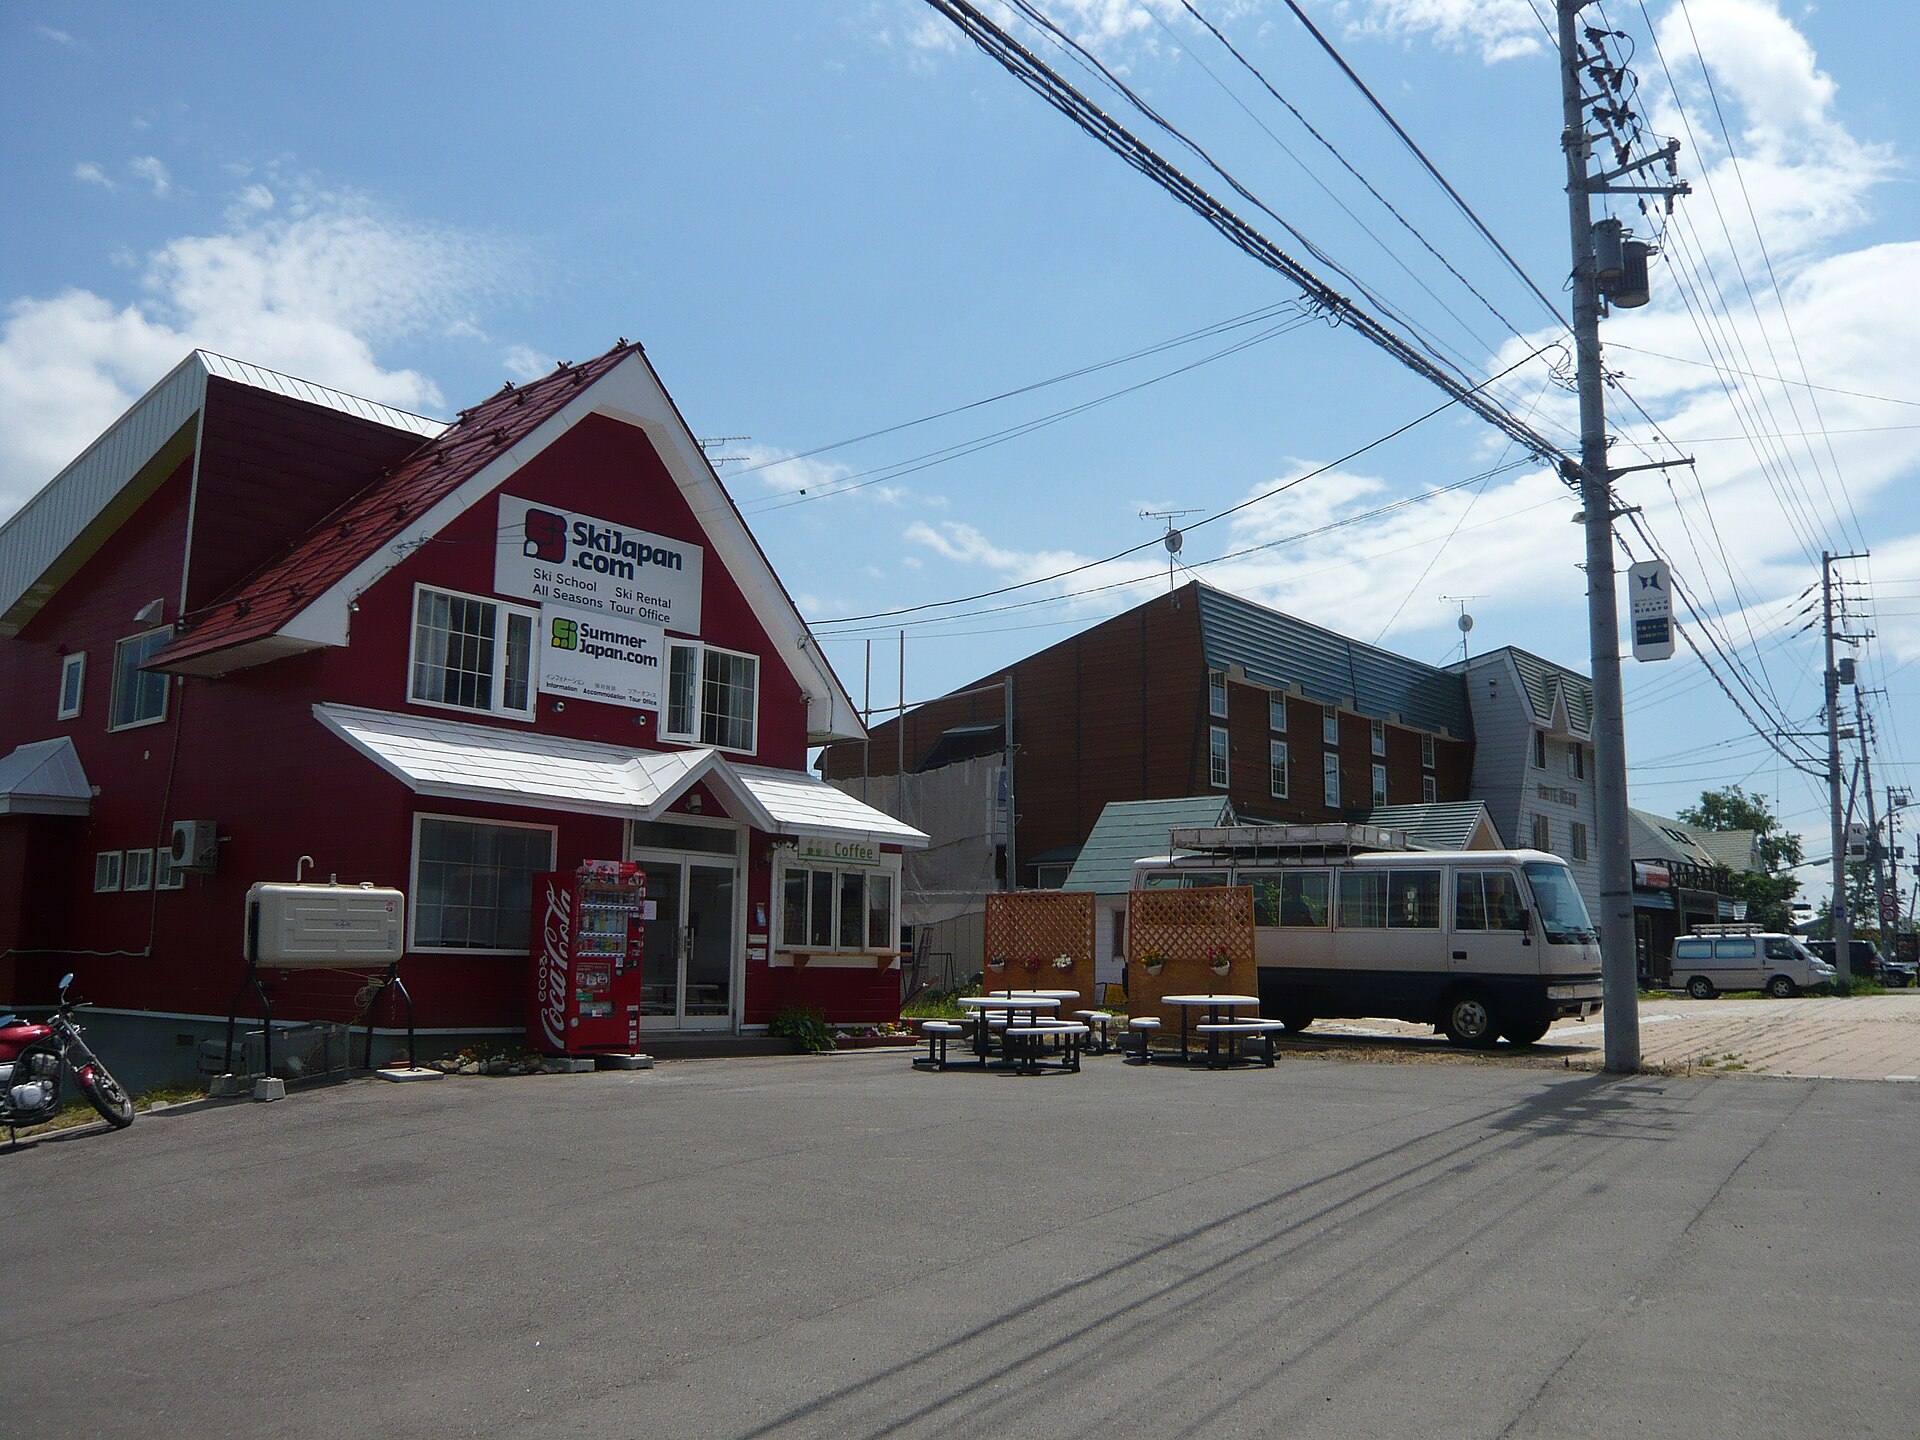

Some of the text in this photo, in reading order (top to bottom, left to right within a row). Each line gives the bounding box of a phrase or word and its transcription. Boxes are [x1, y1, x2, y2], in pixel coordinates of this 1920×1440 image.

[572, 521, 682, 571] SkiJapan
[572, 551, 634, 580] .com
[533, 568, 672, 609] Ski School Ski Rental
[533, 584, 671, 623] All Seasons Tour Office
[580, 623, 647, 649] Summer
[579, 638, 658, 667] Japan.com
[546, 681, 657, 706] Information Accommodation Tour Office
[834, 842, 873, 859] Coffee
[540, 879, 571, 1050] Coca-Cola
